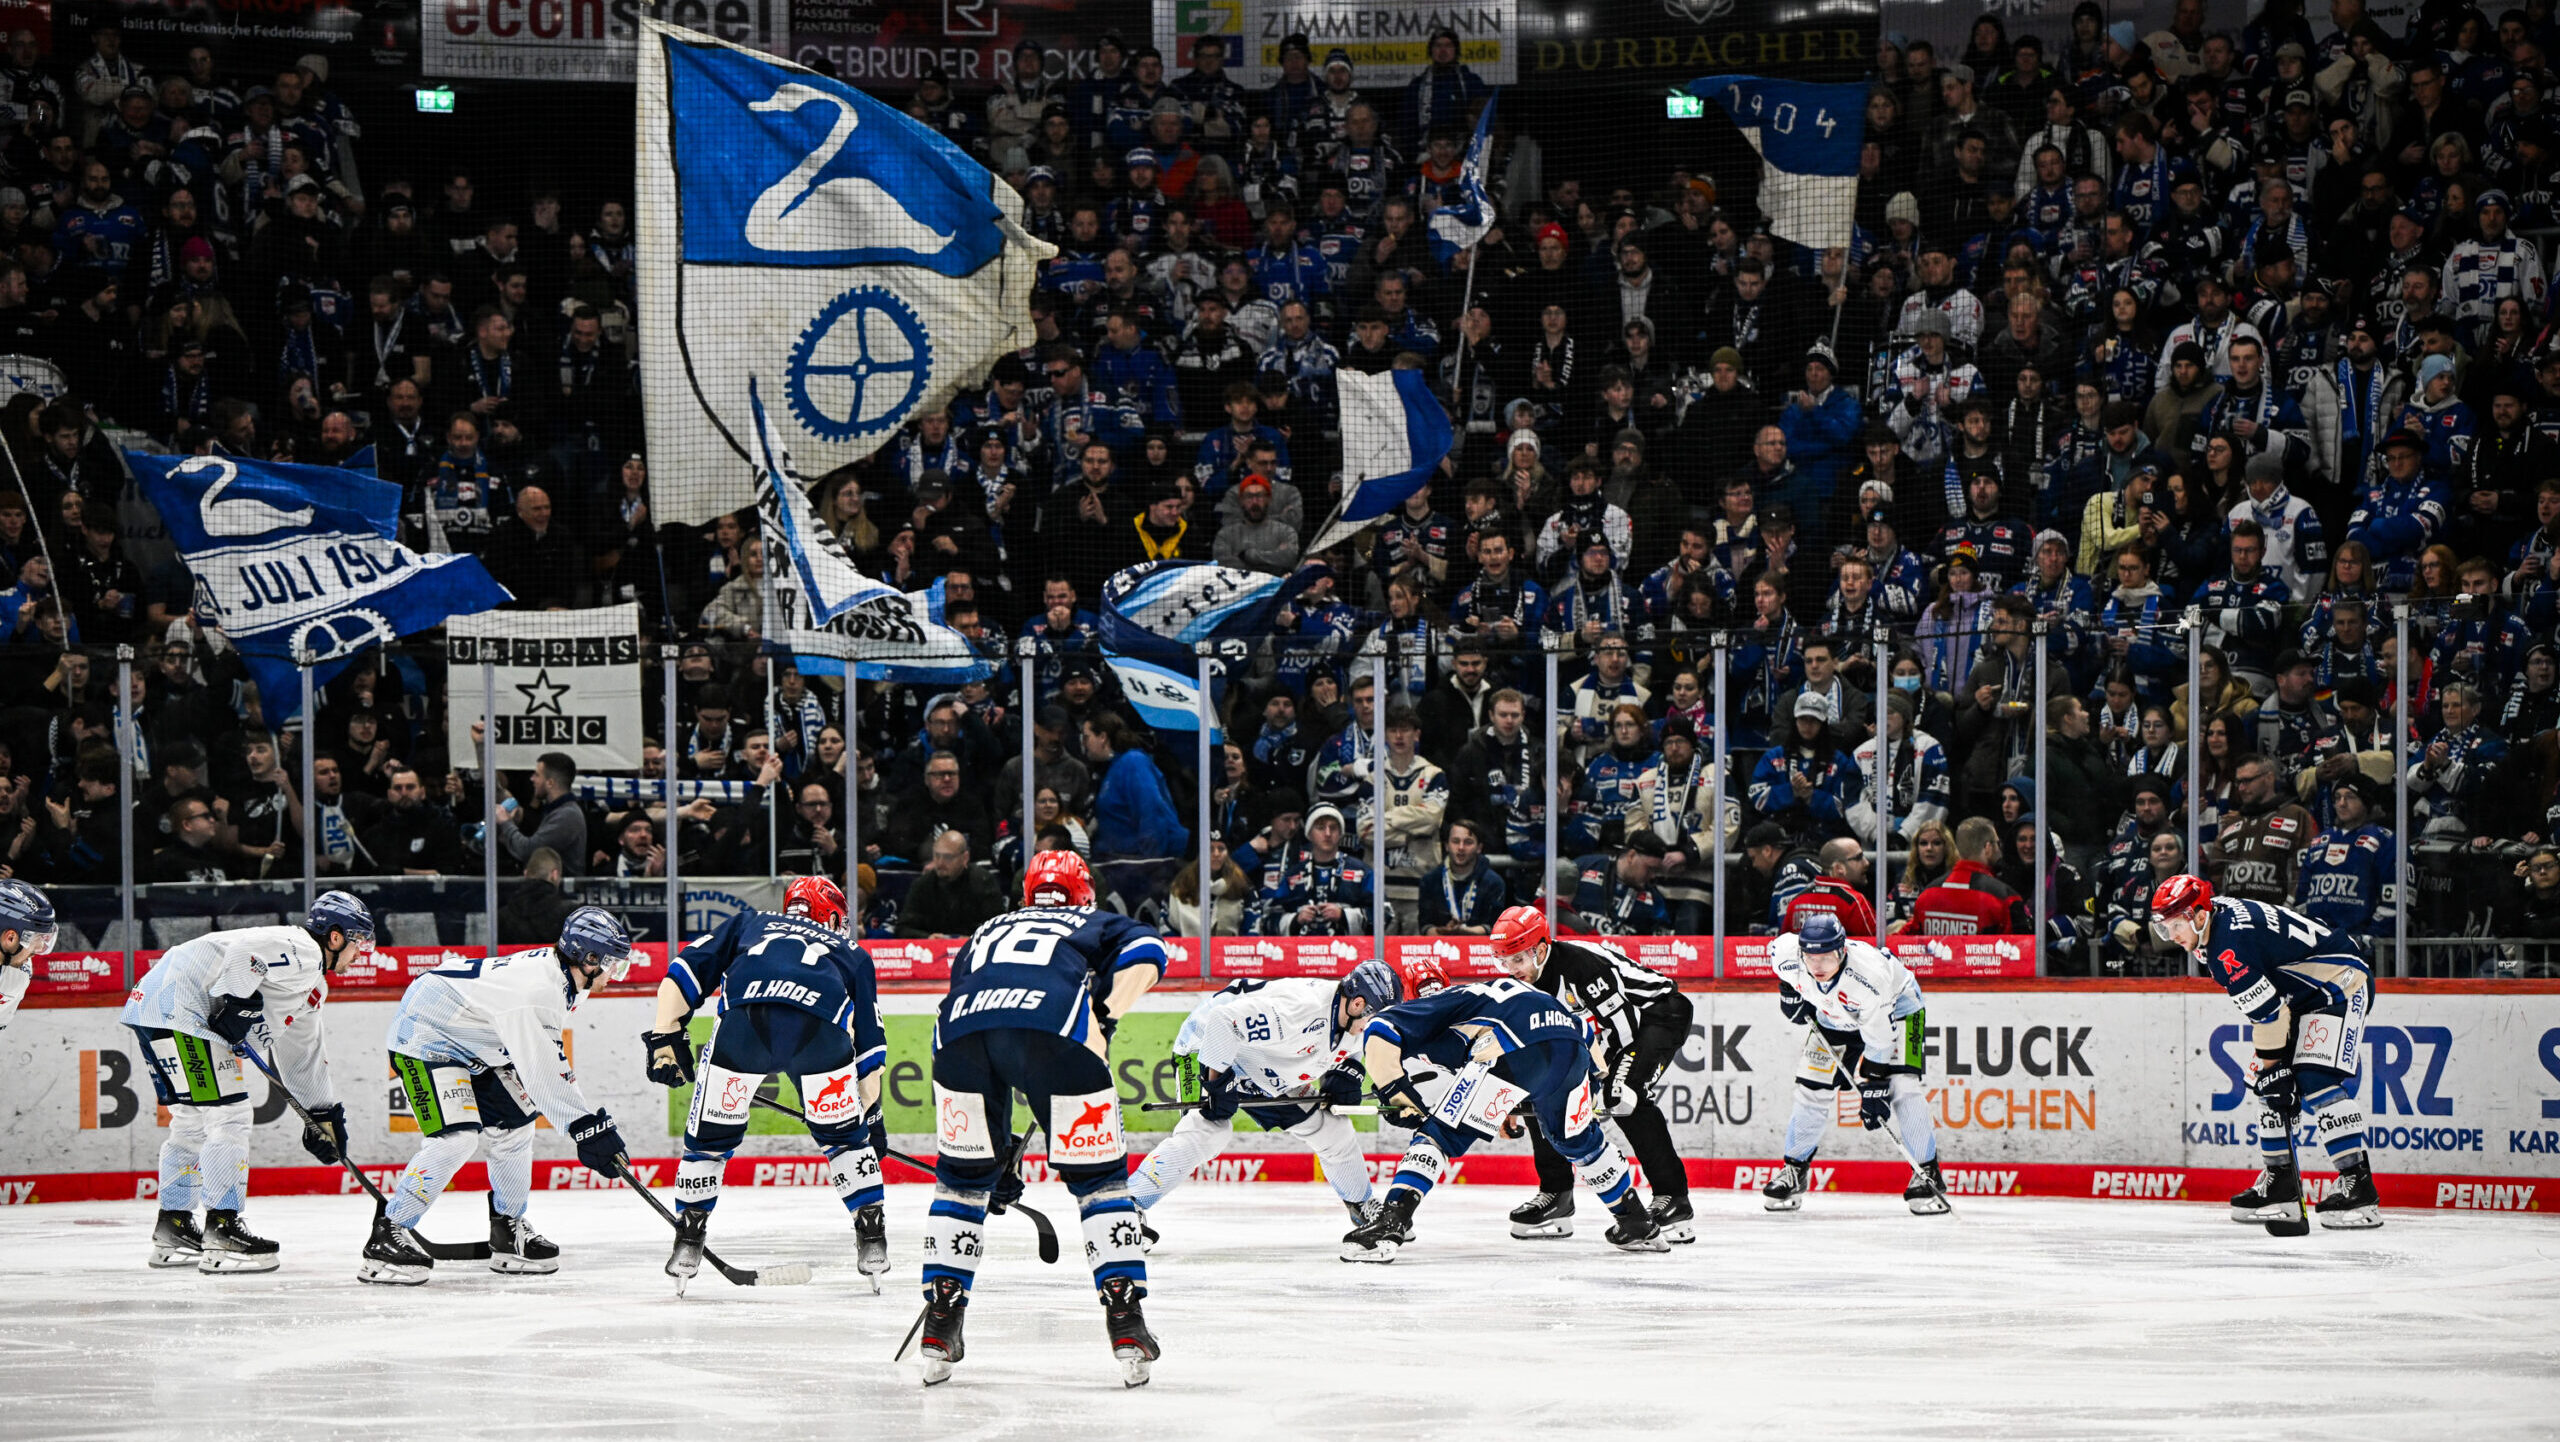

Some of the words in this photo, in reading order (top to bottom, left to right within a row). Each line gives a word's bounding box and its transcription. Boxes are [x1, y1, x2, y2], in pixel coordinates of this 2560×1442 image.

[69, 13, 89, 27] Ihr
[157, 18, 177, 33] für
[179, 21, 250, 39] technische
[254, 24, 354, 44] Federlösungen
[1262, 8, 1502, 38] ZIMMERMANN
[795, 44, 979, 80] GEBRÜDER
[1535, 29, 1865, 71] DURBACHER
[1727, 84, 1837, 139] 1904
[239, 555, 325, 610] JULI
[1393, 795, 1408, 807] 88
[763, 921, 841, 949] SZWARZ
[1923, 917, 1978, 935] ORDNER
[871, 947, 904, 958] WERNER
[1223, 945, 1255, 956] WERNER
[1297, 944, 1328, 955] WERNER
[1297, 955, 1338, 966] WOHNBAU
[1401, 944, 1432, 955] WERNER
[1640, 945, 1670, 956] WERNER
[1736, 945, 1766, 956] WERNER
[1965, 944, 1995, 954] WERNER
[1965, 955, 2001, 967] WOHNBAU
[48, 960, 81, 971] WERNER
[872, 958, 912, 969] WOHNBAU
[1223, 956, 1263, 967] WOHNBAU
[1640, 956, 1678, 967] WOHNBAU
[48, 971, 89, 982] WOHNBAU
[1586, 976, 1610, 1000] 94
[2238, 978, 2272, 1007] SCHOLZ
[1245, 1012, 1271, 1042] 38
[1612, 1053, 1634, 1098] PENNY
[2209, 1024, 2453, 1116] SRZ
[819, 1096, 854, 1112] ORCA
[1443, 1077, 1472, 1117] STORZ
[1072, 1132, 1114, 1148] ORCA
[2182, 1122, 2240, 1145] KARL
[2358, 1126, 2483, 1151] NDOSKOPE
[2509, 1130, 2560, 1153] KAR
[340, 1168, 398, 1194] PEN
[548, 1165, 661, 1189] PENNY
[753, 1162, 833, 1186] PENN
[1946, 1169, 2019, 1194] ENNY
[2091, 1171, 2186, 1197] PENNY
[2435, 1182, 2536, 1209] PENNY
